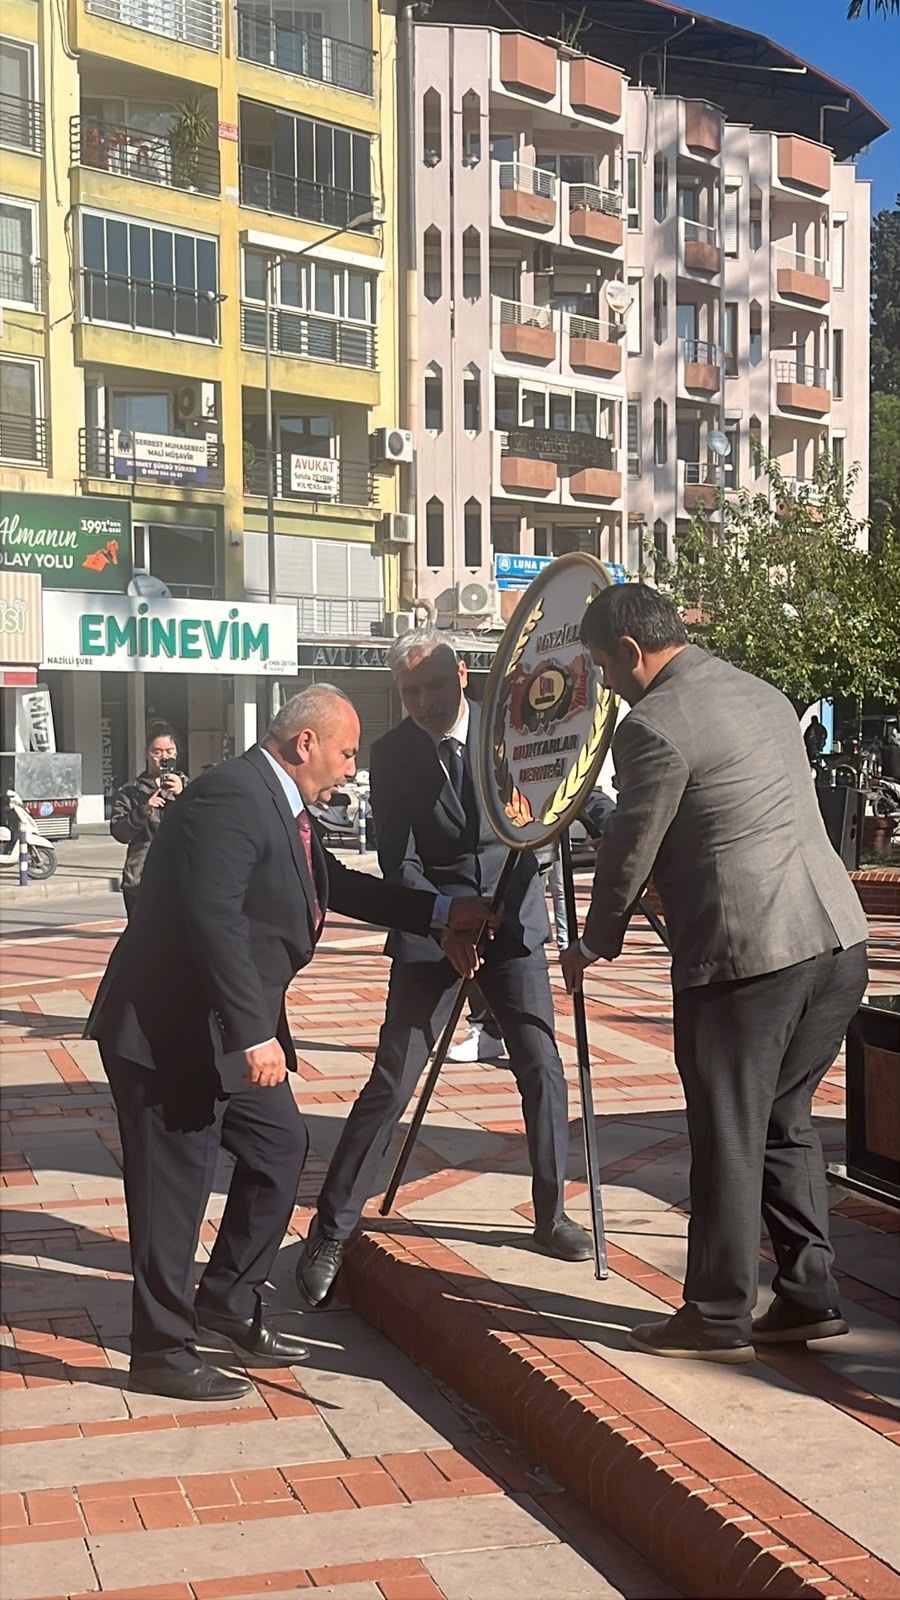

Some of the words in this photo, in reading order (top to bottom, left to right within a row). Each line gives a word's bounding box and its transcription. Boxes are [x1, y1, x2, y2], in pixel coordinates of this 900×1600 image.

[294, 458, 334, 473] AVUKAT
[0, 551, 32, 567] LAY
[34, 554, 74, 569] YOLU
[513, 560, 537, 570] LUNA
[79, 602, 269, 661] EMİNEVİM
